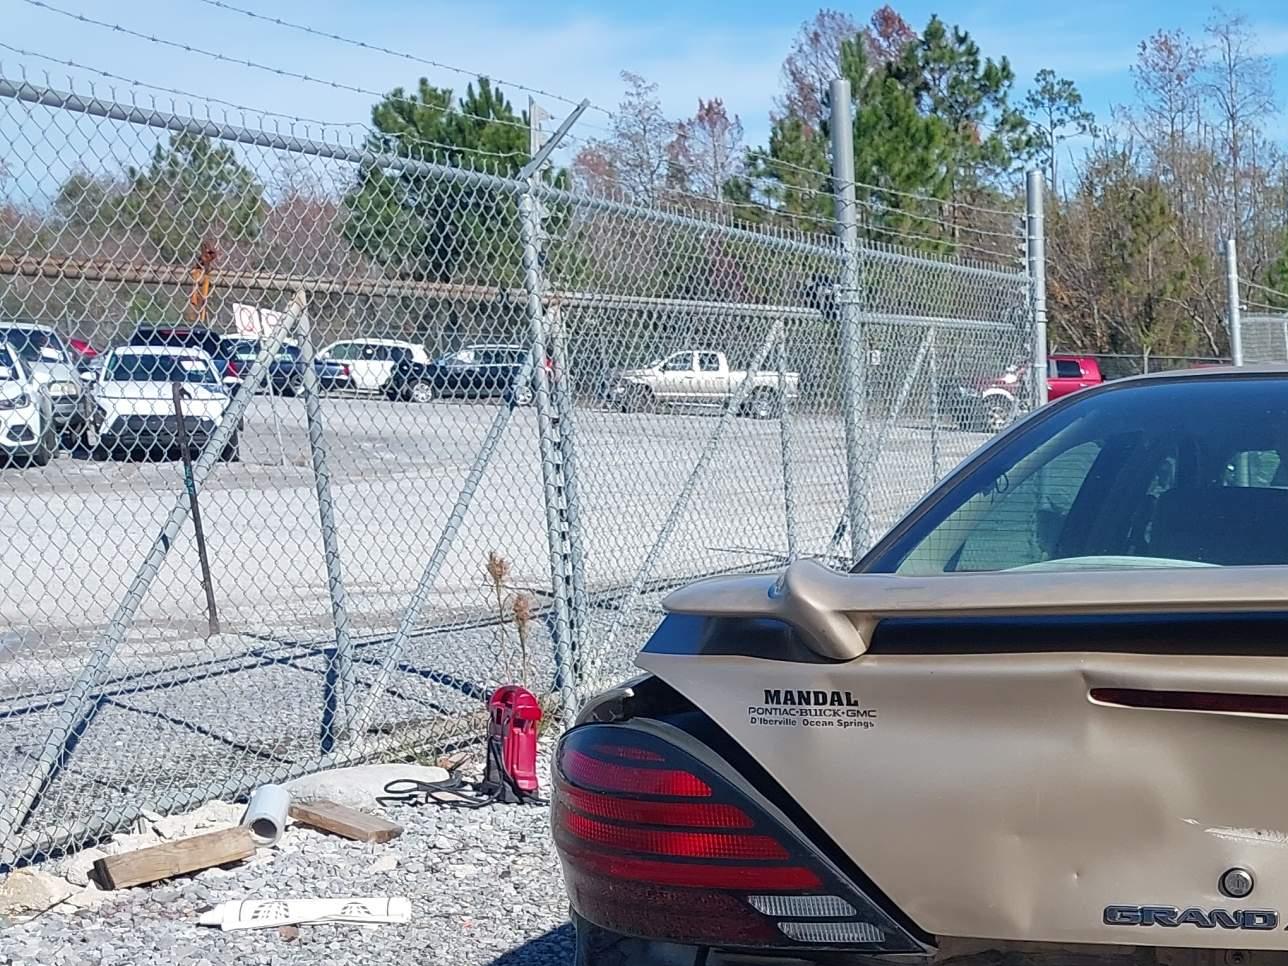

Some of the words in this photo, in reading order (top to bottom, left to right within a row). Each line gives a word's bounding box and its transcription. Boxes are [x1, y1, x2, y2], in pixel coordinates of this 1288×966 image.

[764, 689, 859, 707] MANDAL
[750, 717, 797, 727] D'Iberville
[802, 719, 834, 727] Ocean
[837, 719, 875, 729] Springs
[1103, 905, 1279, 931] GRAND
